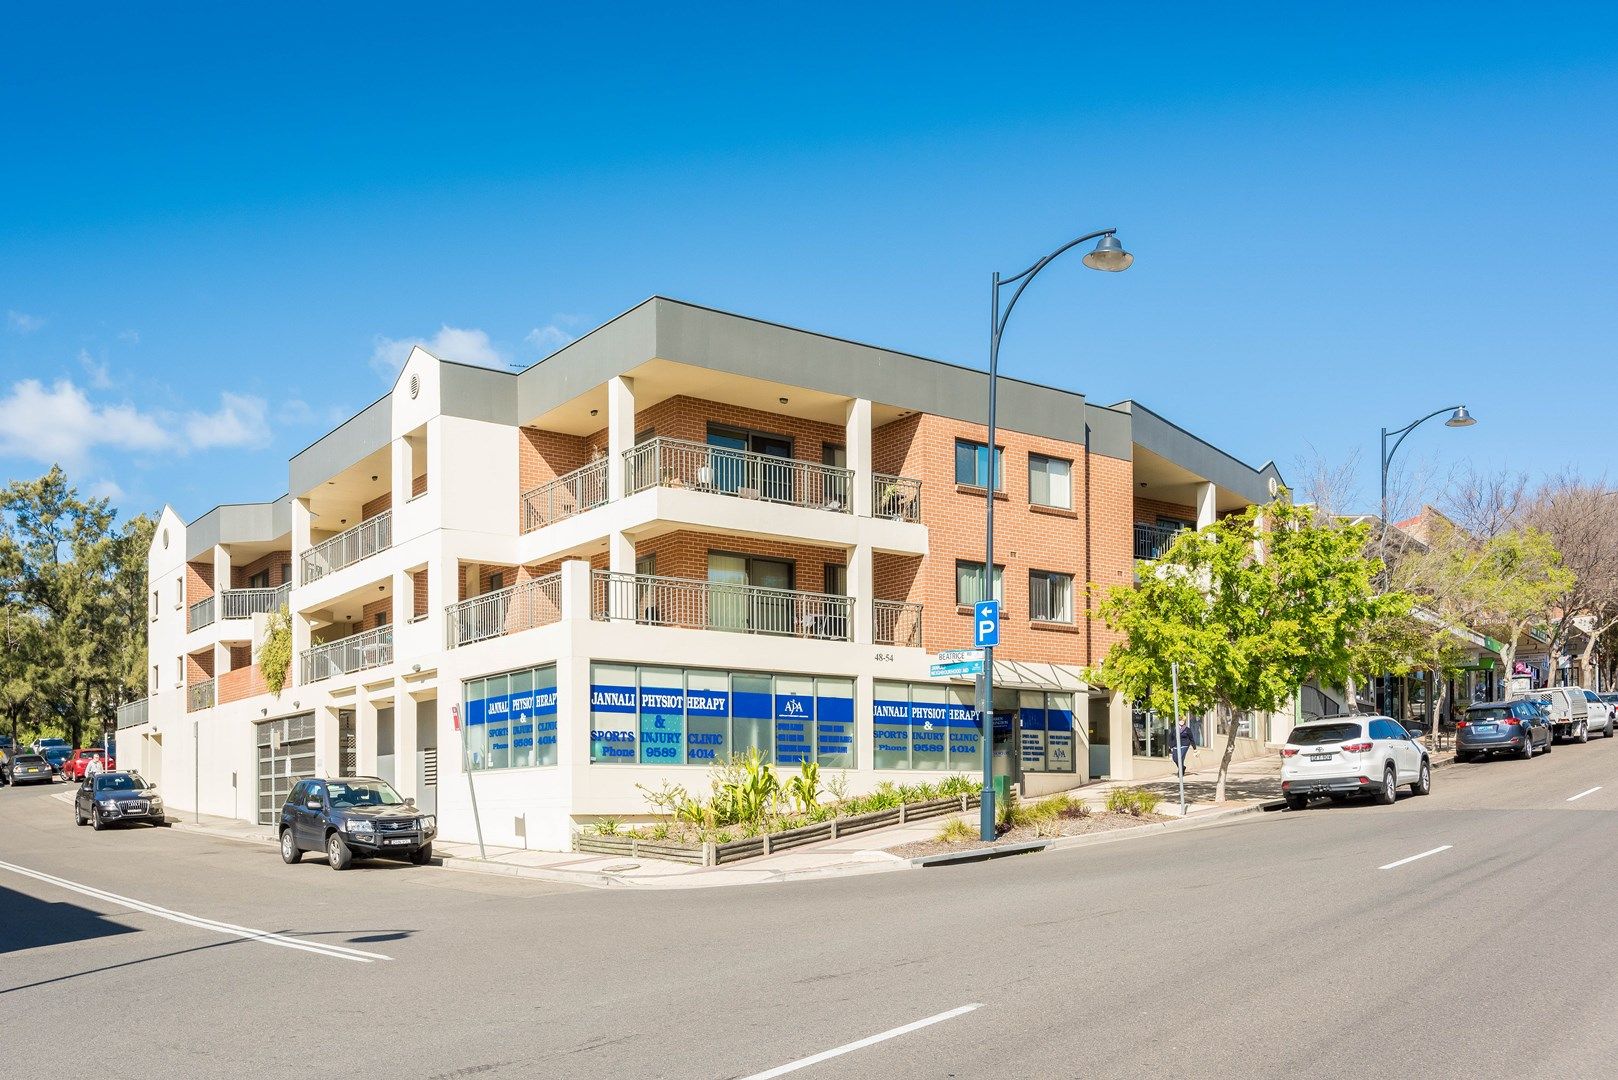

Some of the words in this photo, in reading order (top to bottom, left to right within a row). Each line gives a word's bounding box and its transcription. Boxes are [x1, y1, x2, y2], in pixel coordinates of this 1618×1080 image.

[979, 621, 995, 642] P
[874, 653, 894, 662] 48-54
[938, 651, 965, 661] BEATRICE
[591, 692, 635, 706] JANNALI
[872, 705, 908, 717] JANNALI
[520, 713, 527, 723] &
[654, 714, 666, 729] &
[923, 720, 933, 731] &
[513, 738, 533, 748] 9589
[537, 735, 557, 745] 4014
[590, 730, 635, 742] SPORTS
[640, 732, 682, 744] INJURY
[687, 733, 723, 745] CLINIC
[873, 730, 908, 740] SPORTS
[912, 731, 945, 741] INJURY
[949, 733, 979, 742] CLINIC
[601, 746, 635, 757] Phone
[645, 747, 677, 758] 9589
[688, 748, 715, 759] 4014
[879, 744, 907, 752] Phone
[913, 743, 944, 752] 9589
[949, 745, 976, 753] 4014
